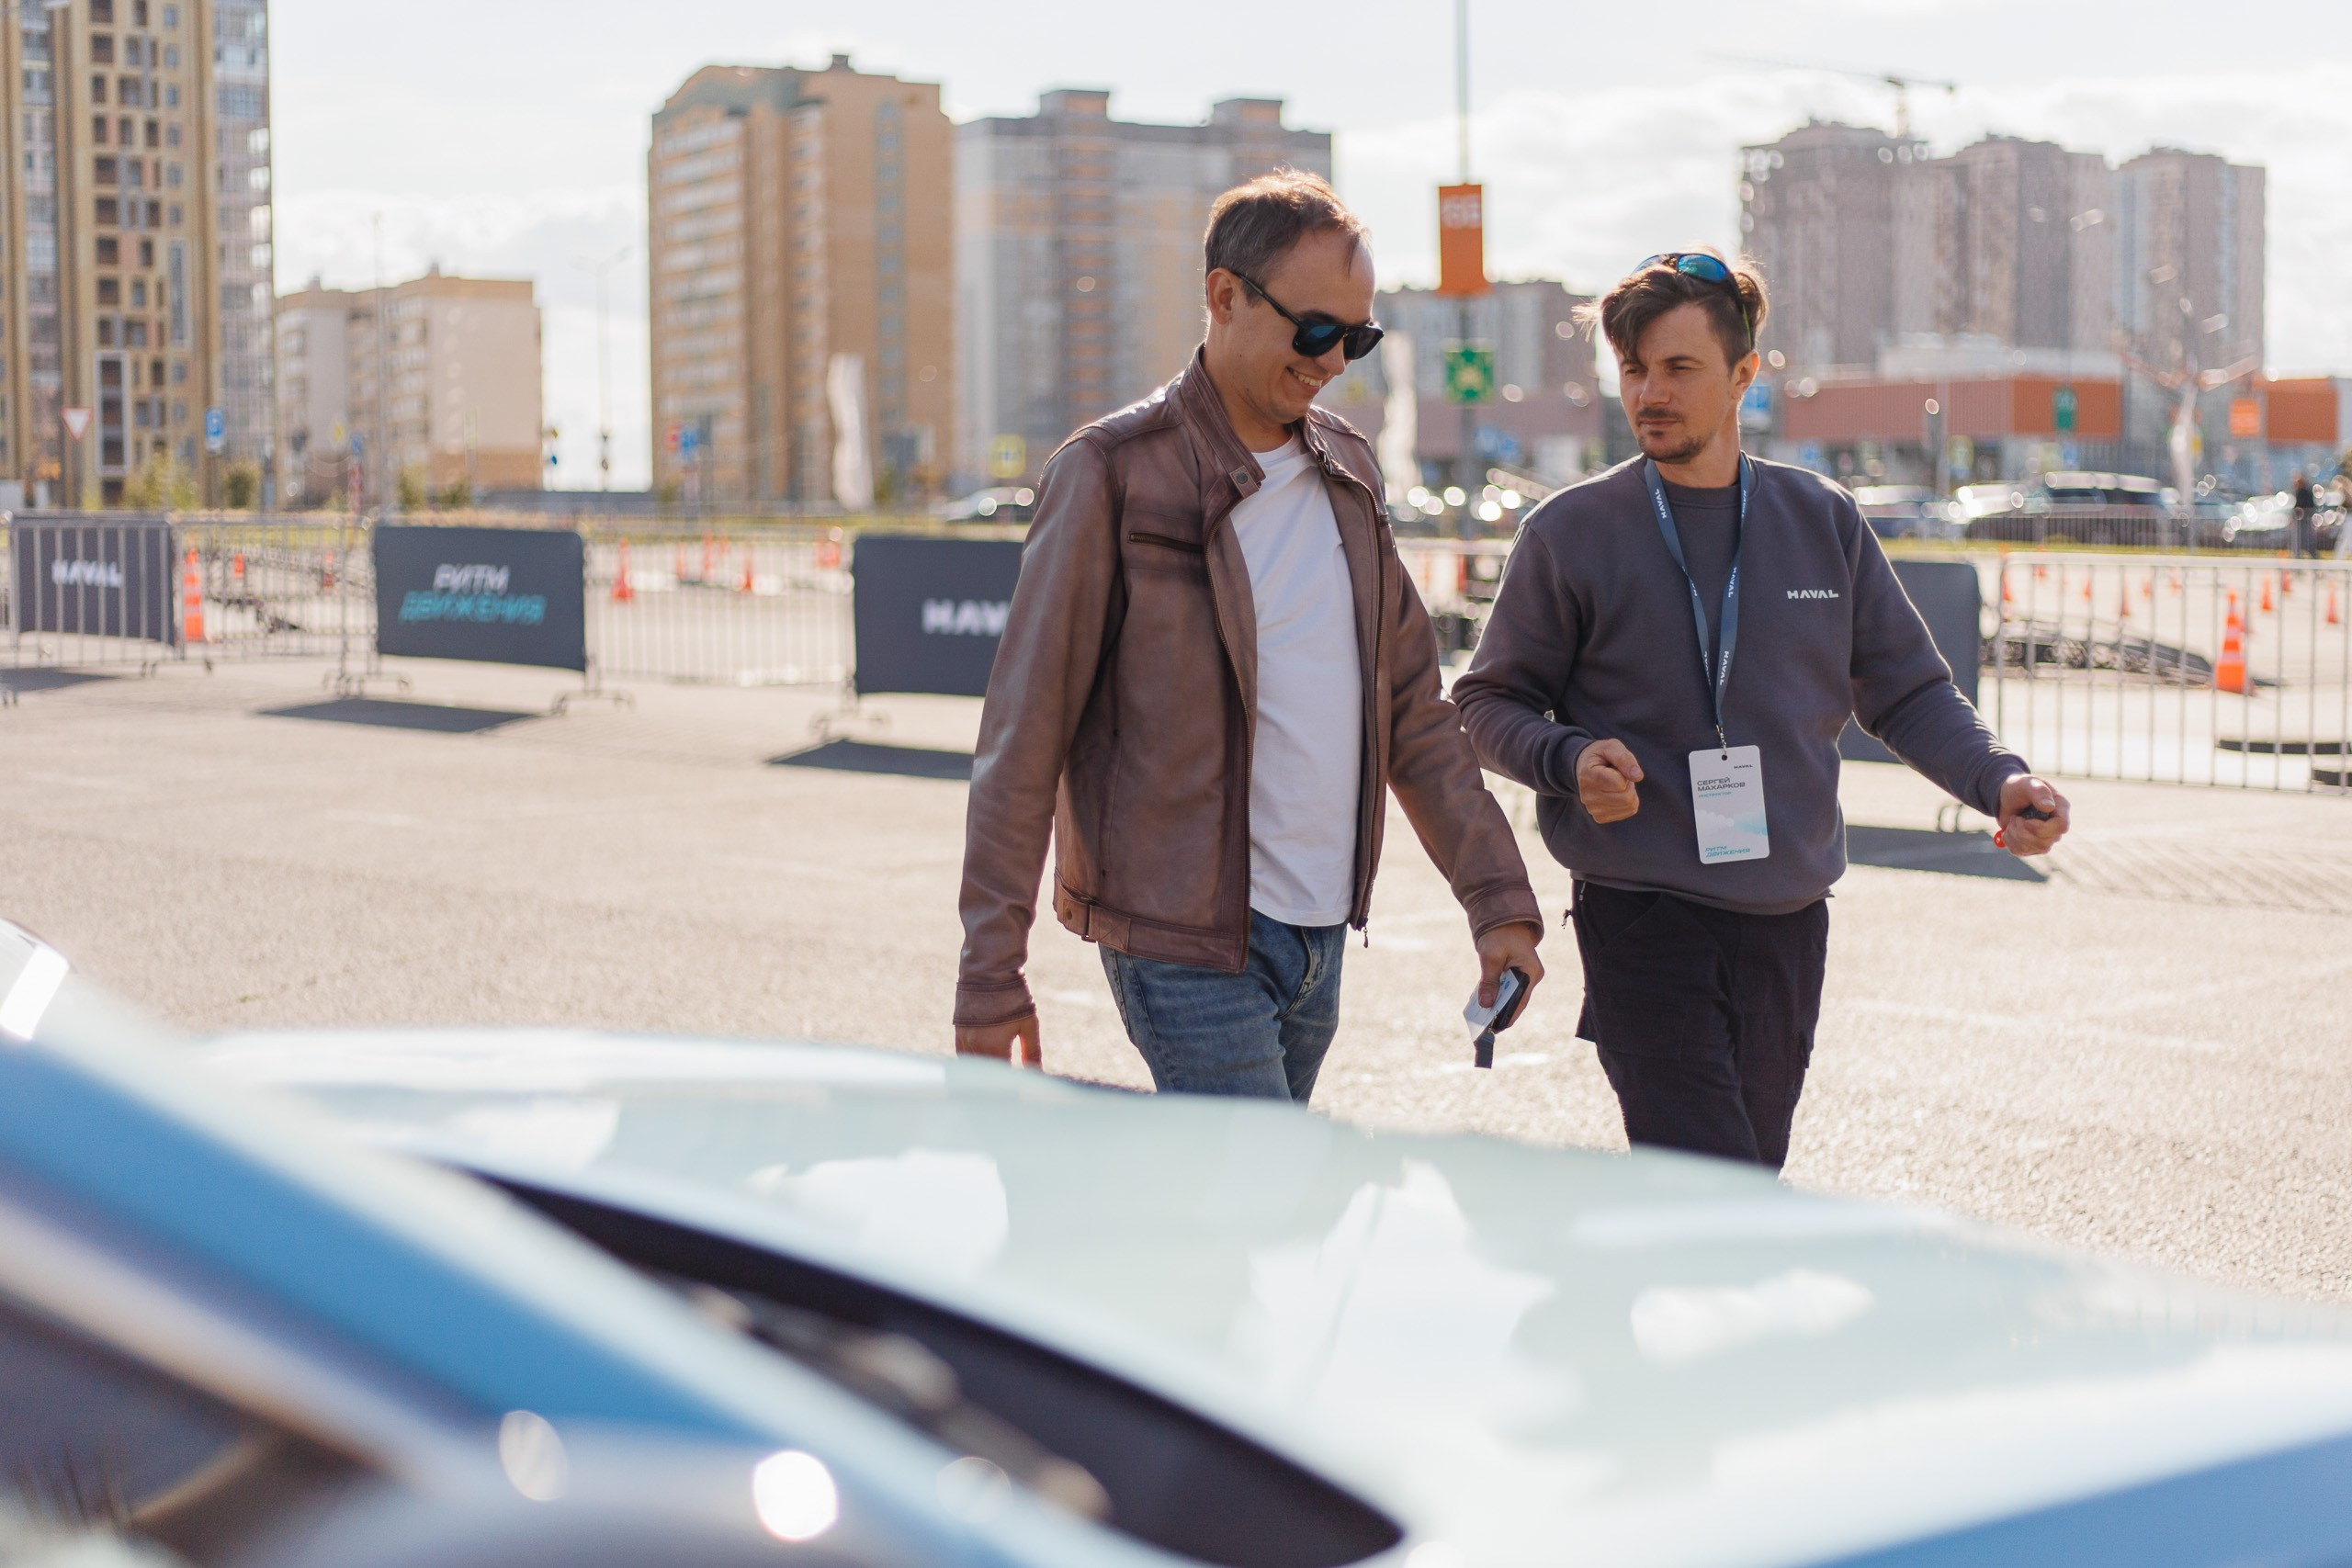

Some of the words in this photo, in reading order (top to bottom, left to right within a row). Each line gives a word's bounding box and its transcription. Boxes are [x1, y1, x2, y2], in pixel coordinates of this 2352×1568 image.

[1655, 488, 1668, 519] HAVAL
[433, 563, 511, 595] РИТМ
[1728, 566, 1737, 598] HAVAL
[1787, 589, 1839, 600] HAVAL
[922, 599, 1010, 636] HAV
[1719, 650, 1729, 686] HAVAL
[1697, 776, 1731, 786] СЕРГЕЙ
[1697, 782, 1746, 792] МАХАРКОВ
